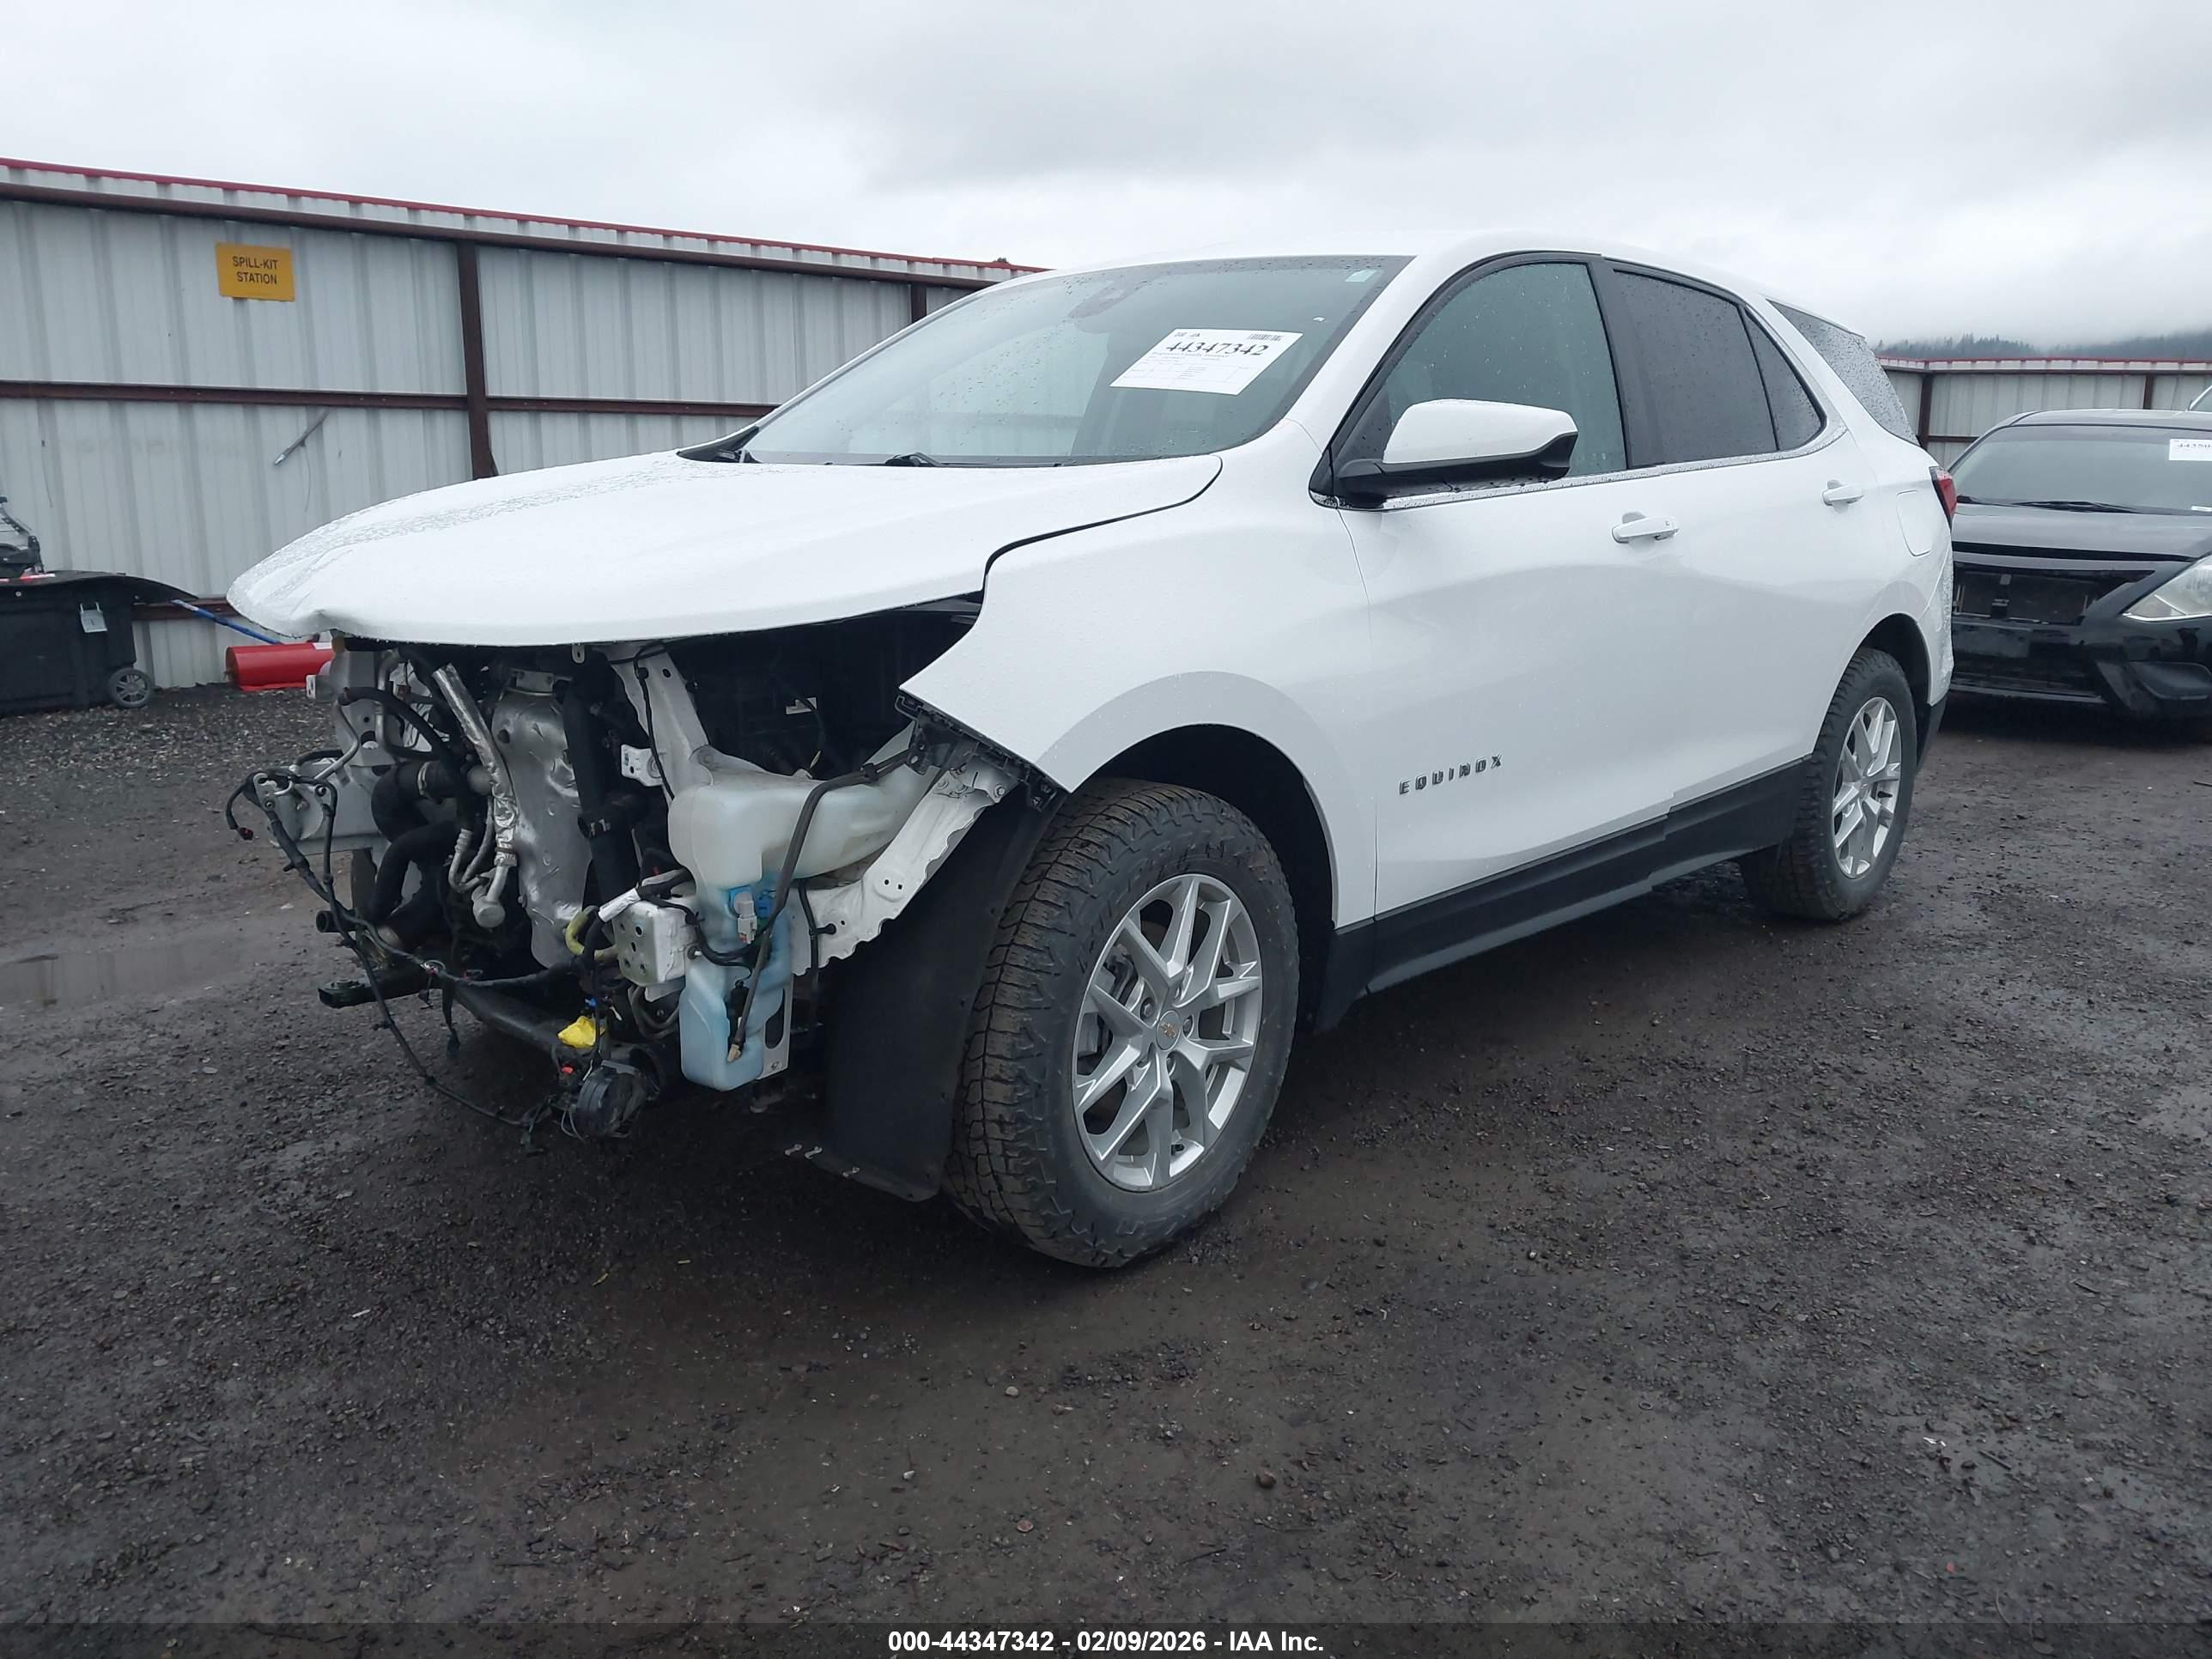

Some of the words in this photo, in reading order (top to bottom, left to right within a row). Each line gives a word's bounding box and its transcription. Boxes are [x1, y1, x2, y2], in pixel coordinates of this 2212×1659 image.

[232, 256, 278, 270] SPILL-KIT
[236, 271, 277, 284] STATION
[1165, 341, 1268, 356] 44347342
[1399, 755, 1502, 795] EQUINOX
